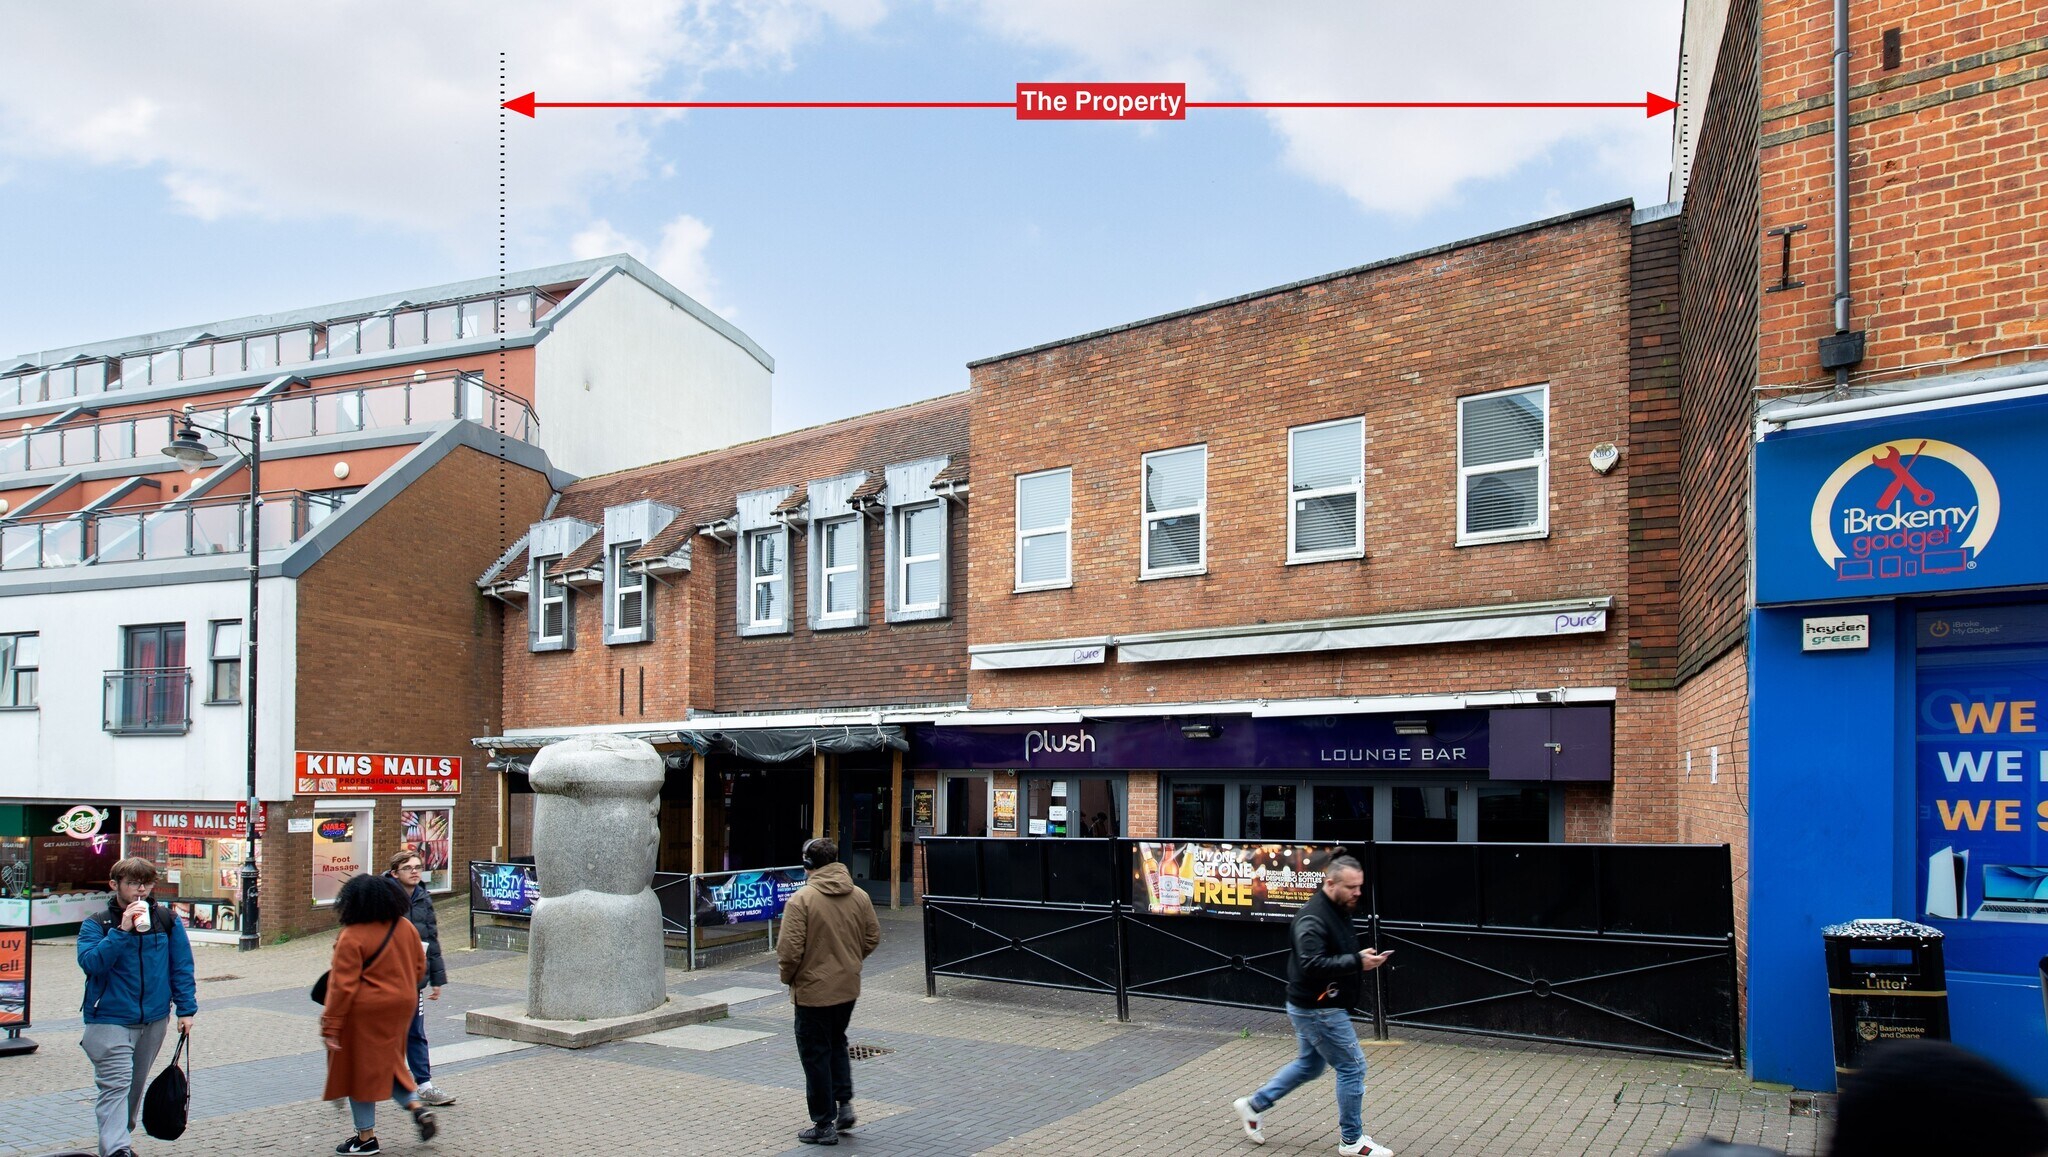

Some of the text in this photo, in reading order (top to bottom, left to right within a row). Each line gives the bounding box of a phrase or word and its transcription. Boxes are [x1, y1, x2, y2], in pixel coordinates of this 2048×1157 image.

[1843, 500, 1978, 534] iBrokemy
[1852, 524, 1952, 559] gadget
[1555, 614, 1597, 633] pure
[1806, 621, 1866, 635] hayden
[1952, 626, 2000, 636] My Gadget
[1812, 634, 1861, 645] green
[1073, 649, 1099, 663] pure
[1950, 701, 2037, 734] WE
[1024, 728, 1096, 763] plush
[1320, 747, 1467, 761] LOUNGE BAR
[307, 755, 452, 776] KIMS NAILS
[1937, 750, 2023, 783] WE
[339, 777, 398, 785] PROFESSIONAL
[152, 814, 189, 828] KIMS
[194, 814, 237, 829] NAILS
[1935, 799, 2022, 832] WE
[1194, 850, 1236, 862] BUY ONE
[322, 864, 359, 872] Massage
[1193, 861, 1252, 878] GET ONE
[480, 873, 525, 889] THIRSTY
[482, 888, 521, 900] THURSDAYS
[709, 881, 775, 900] THIRSTY
[1193, 876, 1253, 906] FREE
[713, 896, 774, 911] THURSDAYS
[0, 939, 21, 951] uy
[0, 960, 19, 972] ell
[1866, 978, 1907, 990] Litter
[1879, 1025, 1925, 1033] Basingstoke
